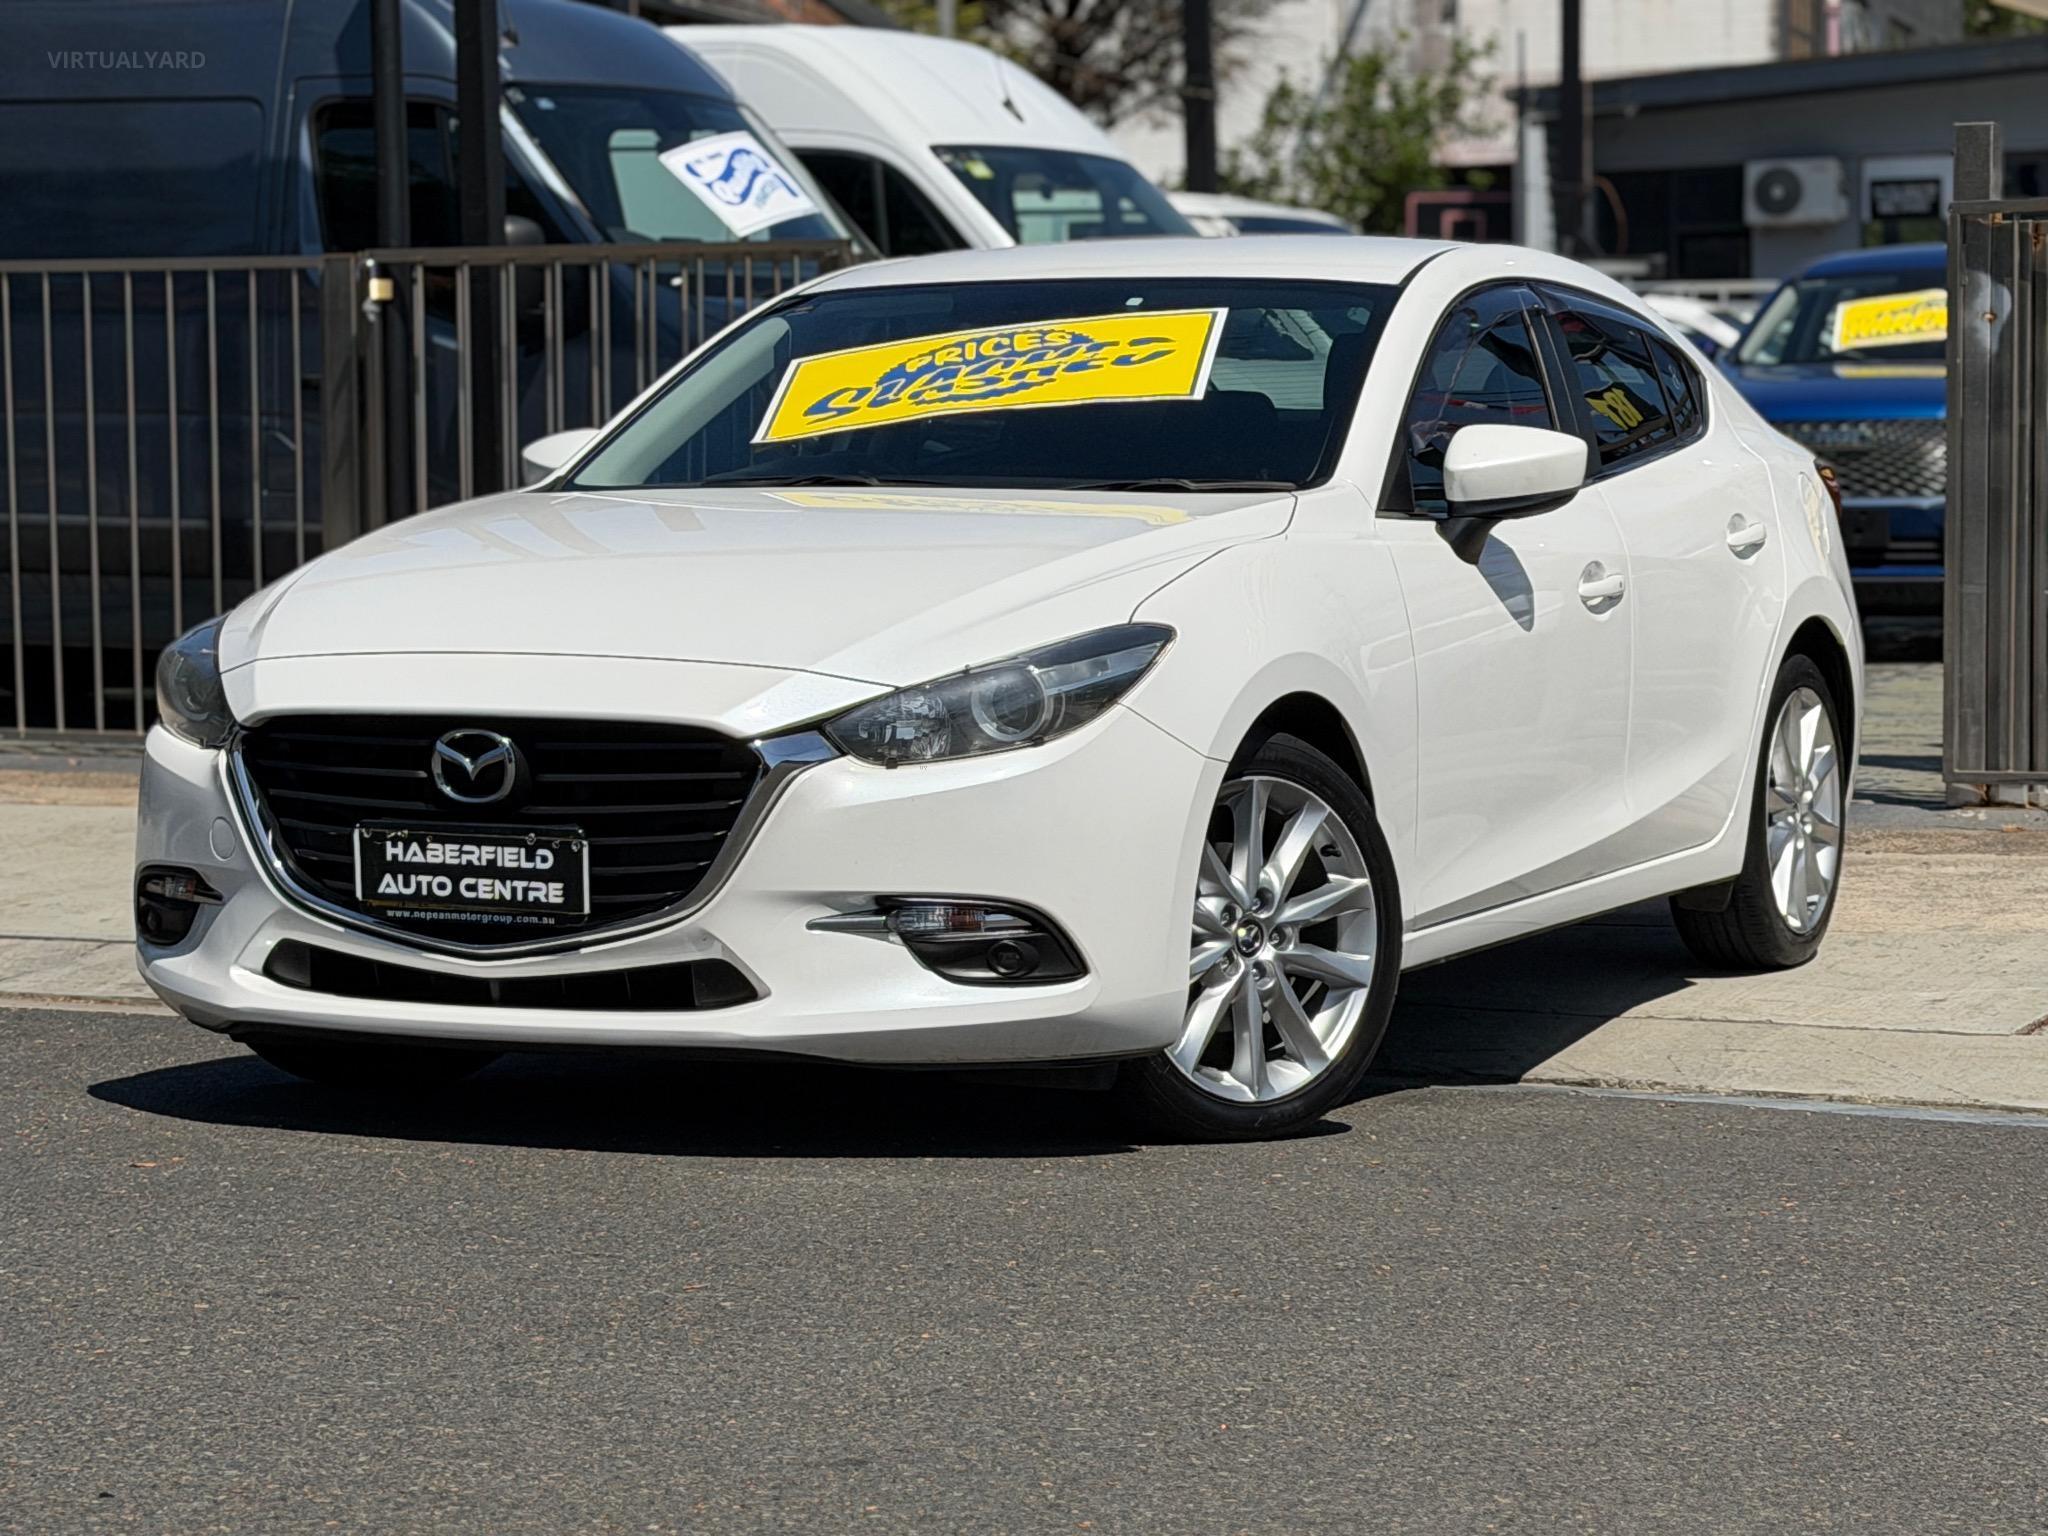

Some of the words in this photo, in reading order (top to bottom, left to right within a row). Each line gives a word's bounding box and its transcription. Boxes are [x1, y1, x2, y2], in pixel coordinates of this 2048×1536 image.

[905, 331, 1073, 373] PRICES
[384, 841, 554, 870] HABERFIELD
[377, 873, 452, 898] AUTO
[459, 877, 565, 904] CENTRE
[386, 909, 555, 925] www.nepeanmotorgroup.com.au
